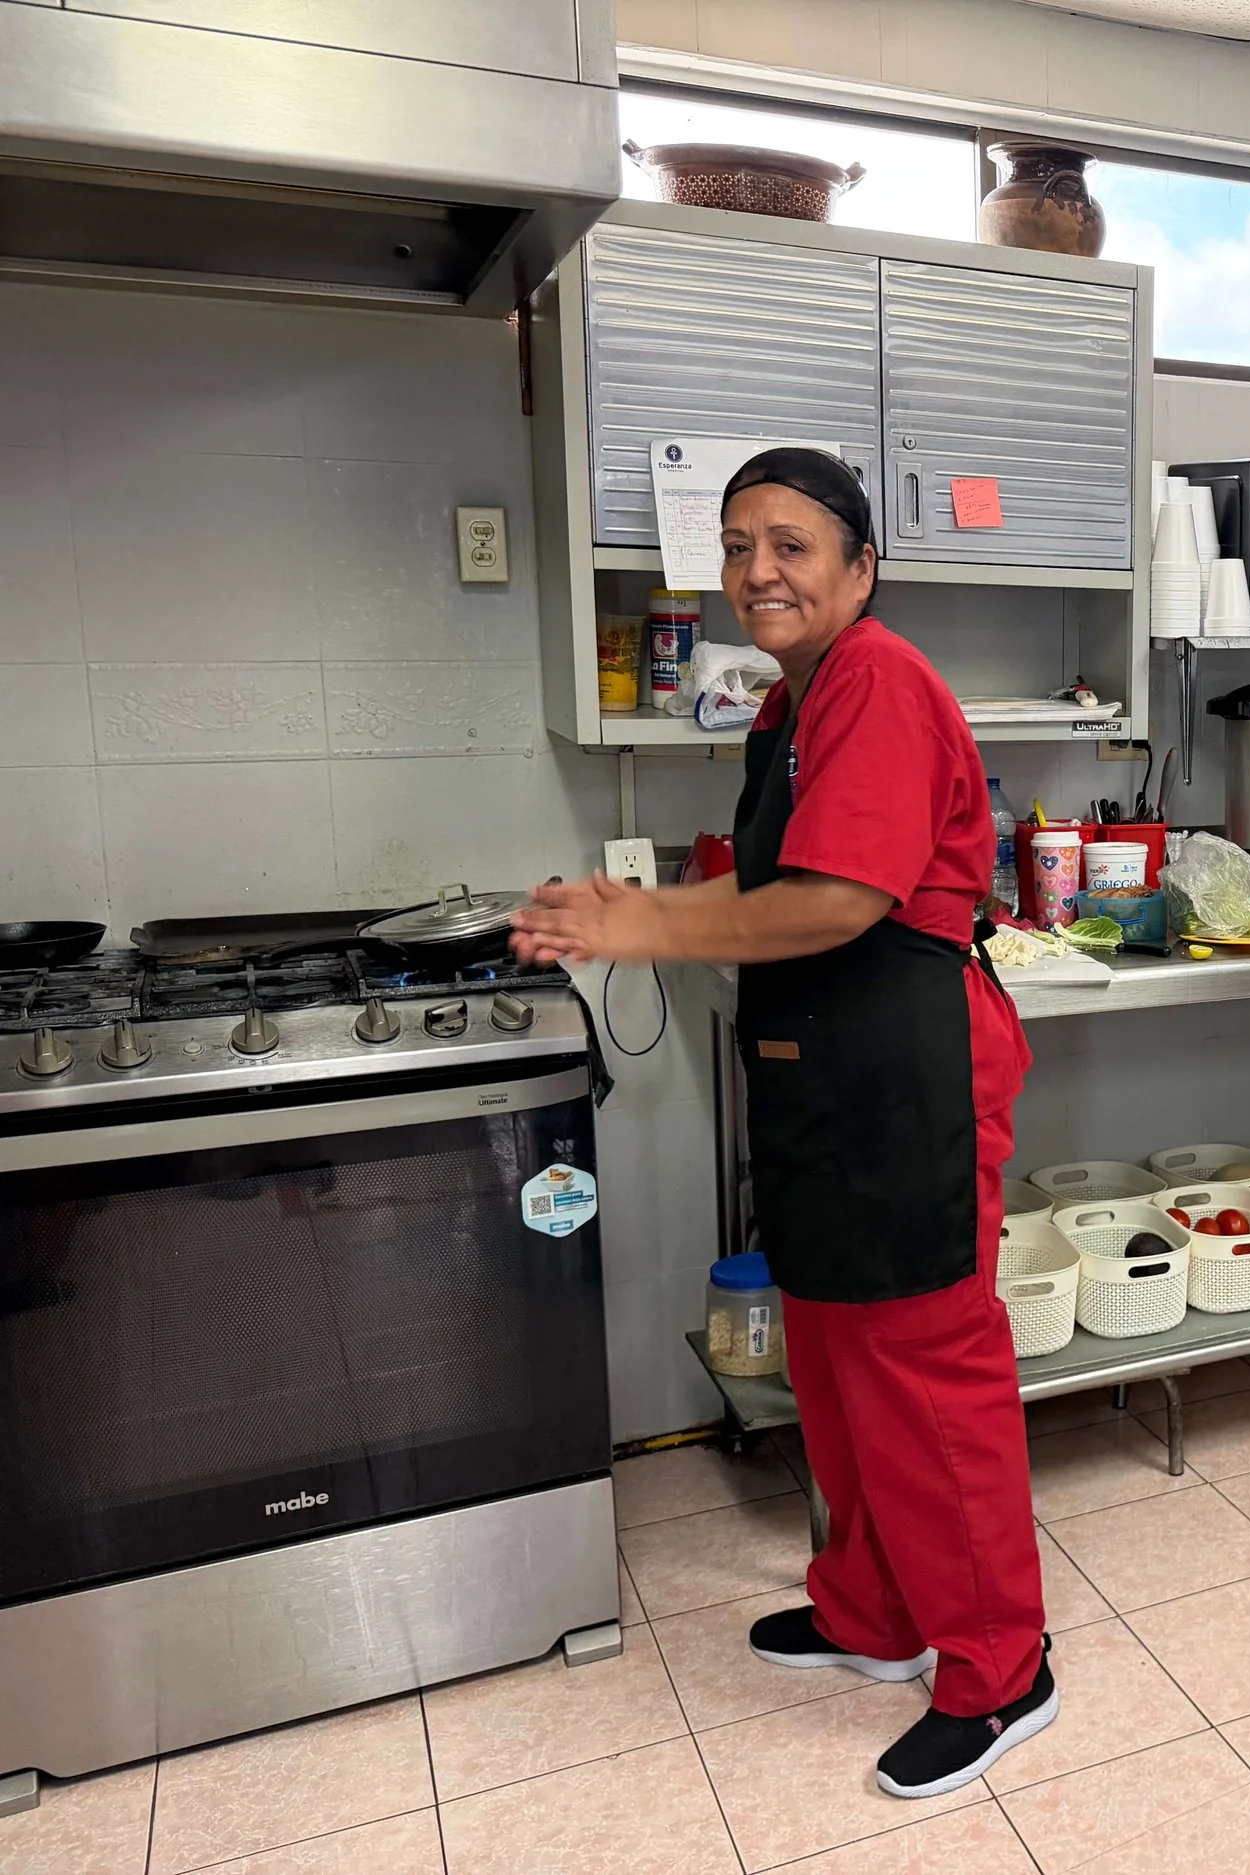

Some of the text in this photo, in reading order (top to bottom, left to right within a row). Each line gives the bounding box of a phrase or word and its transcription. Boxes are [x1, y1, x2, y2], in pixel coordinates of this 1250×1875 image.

[658, 462, 692, 470] Esperanza
[1093, 880, 1138, 890] GRIEGO
[265, 1491, 330, 1516] mabe
